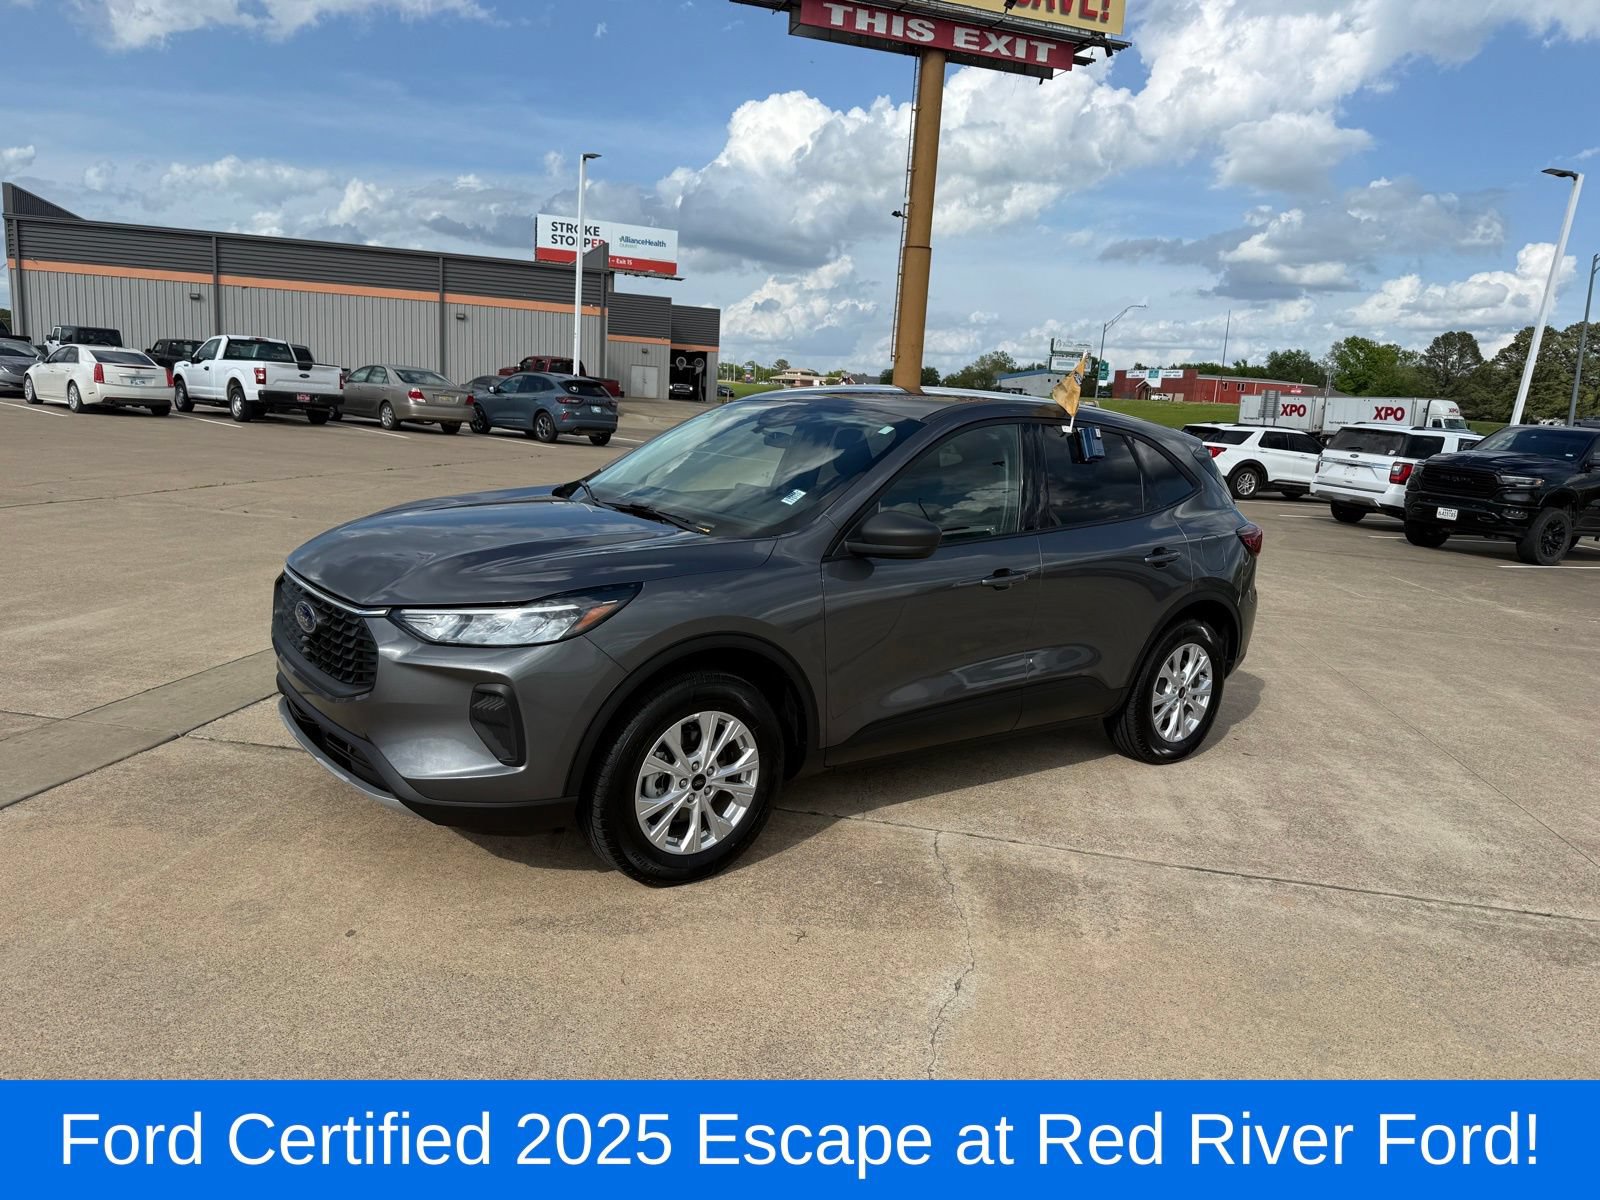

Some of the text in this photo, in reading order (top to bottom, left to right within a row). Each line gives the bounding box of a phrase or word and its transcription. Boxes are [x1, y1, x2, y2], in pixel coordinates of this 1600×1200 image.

[823, 2, 1057, 63] THIS EXIT
[619, 235, 667, 248] AllianceHealth
[1280, 403, 1307, 418] XPO
[1373, 406, 1406, 421] XPO
